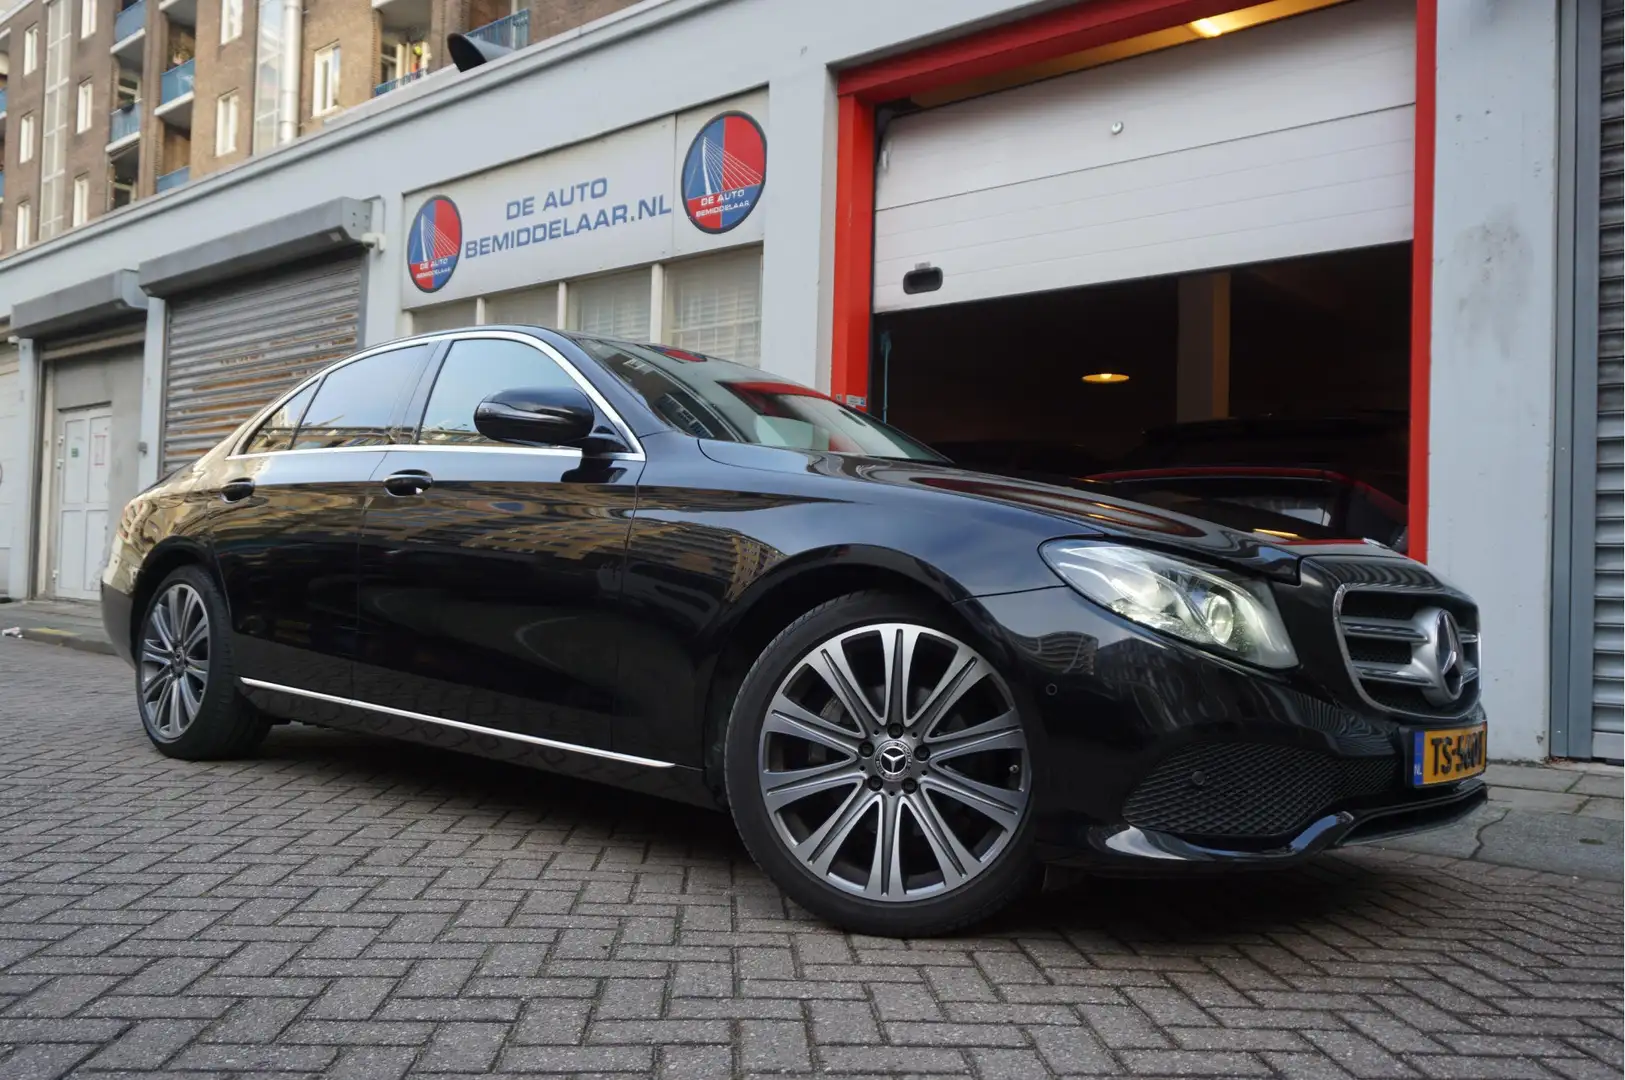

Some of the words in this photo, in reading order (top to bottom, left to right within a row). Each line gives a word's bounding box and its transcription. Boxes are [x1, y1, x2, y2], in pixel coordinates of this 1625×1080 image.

[506, 196, 535, 220] DE
[542, 177, 608, 211] AUTO
[700, 195, 715, 206] DE
[716, 189, 745, 203] AUTO
[695, 200, 750, 218] BEMIDDELAAR
[465, 194, 672, 259] BEMIDDELAAR.NL
[1413, 763, 1423, 776] NL
